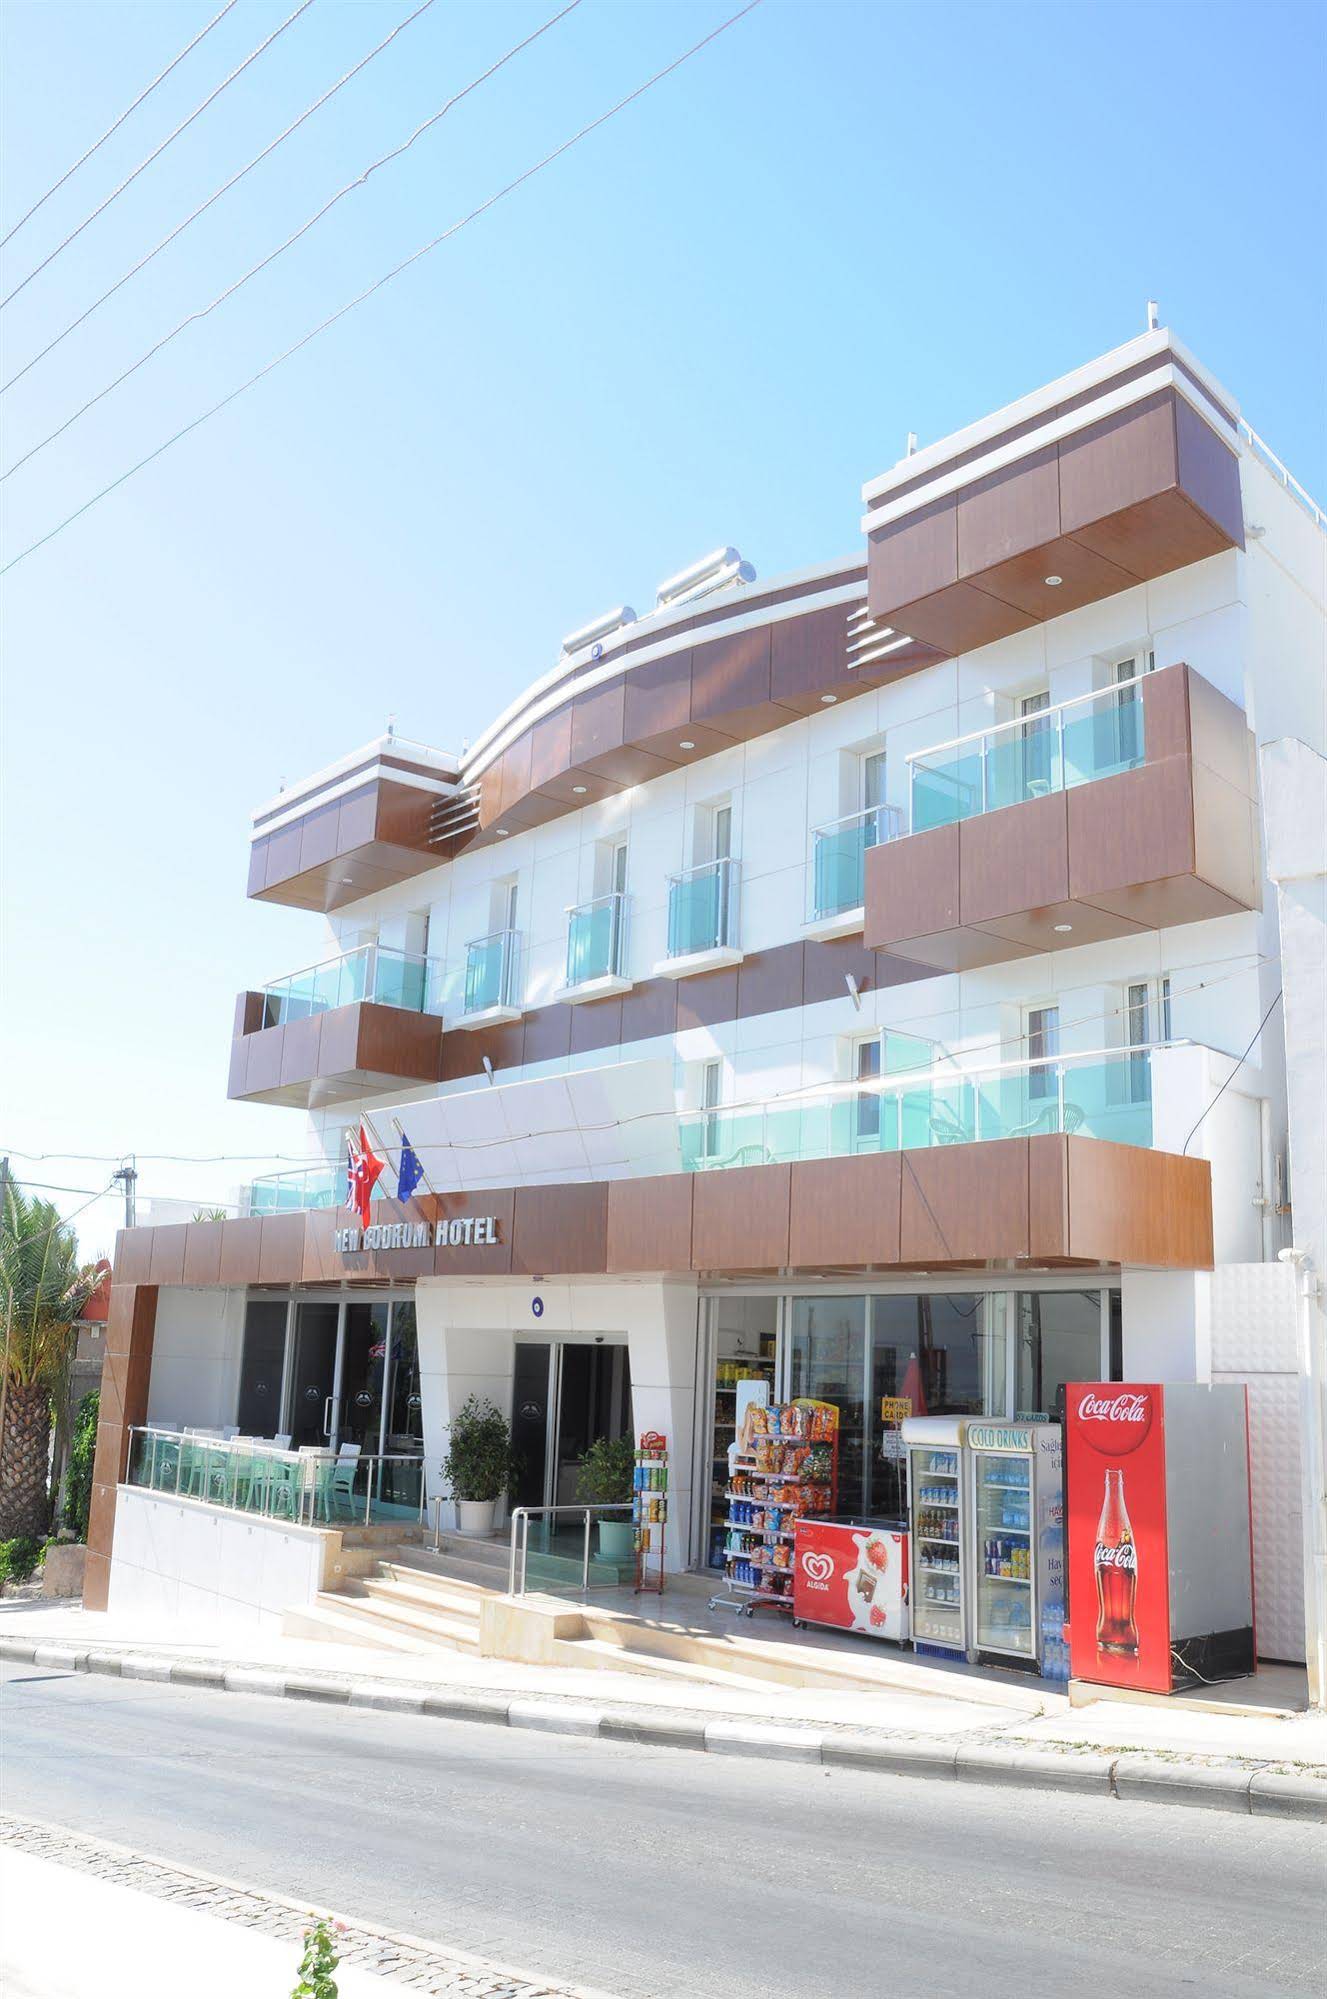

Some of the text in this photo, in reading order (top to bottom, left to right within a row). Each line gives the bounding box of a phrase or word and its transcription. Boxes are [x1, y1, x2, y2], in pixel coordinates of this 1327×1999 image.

[336, 1216, 497, 1252] NEW BODRUM HOTEL
[1079, 1393, 1148, 1422] Coca-Cola
[971, 1428, 1028, 1449] COLD DRINKS
[806, 1580, 829, 1592] ALGIDA
